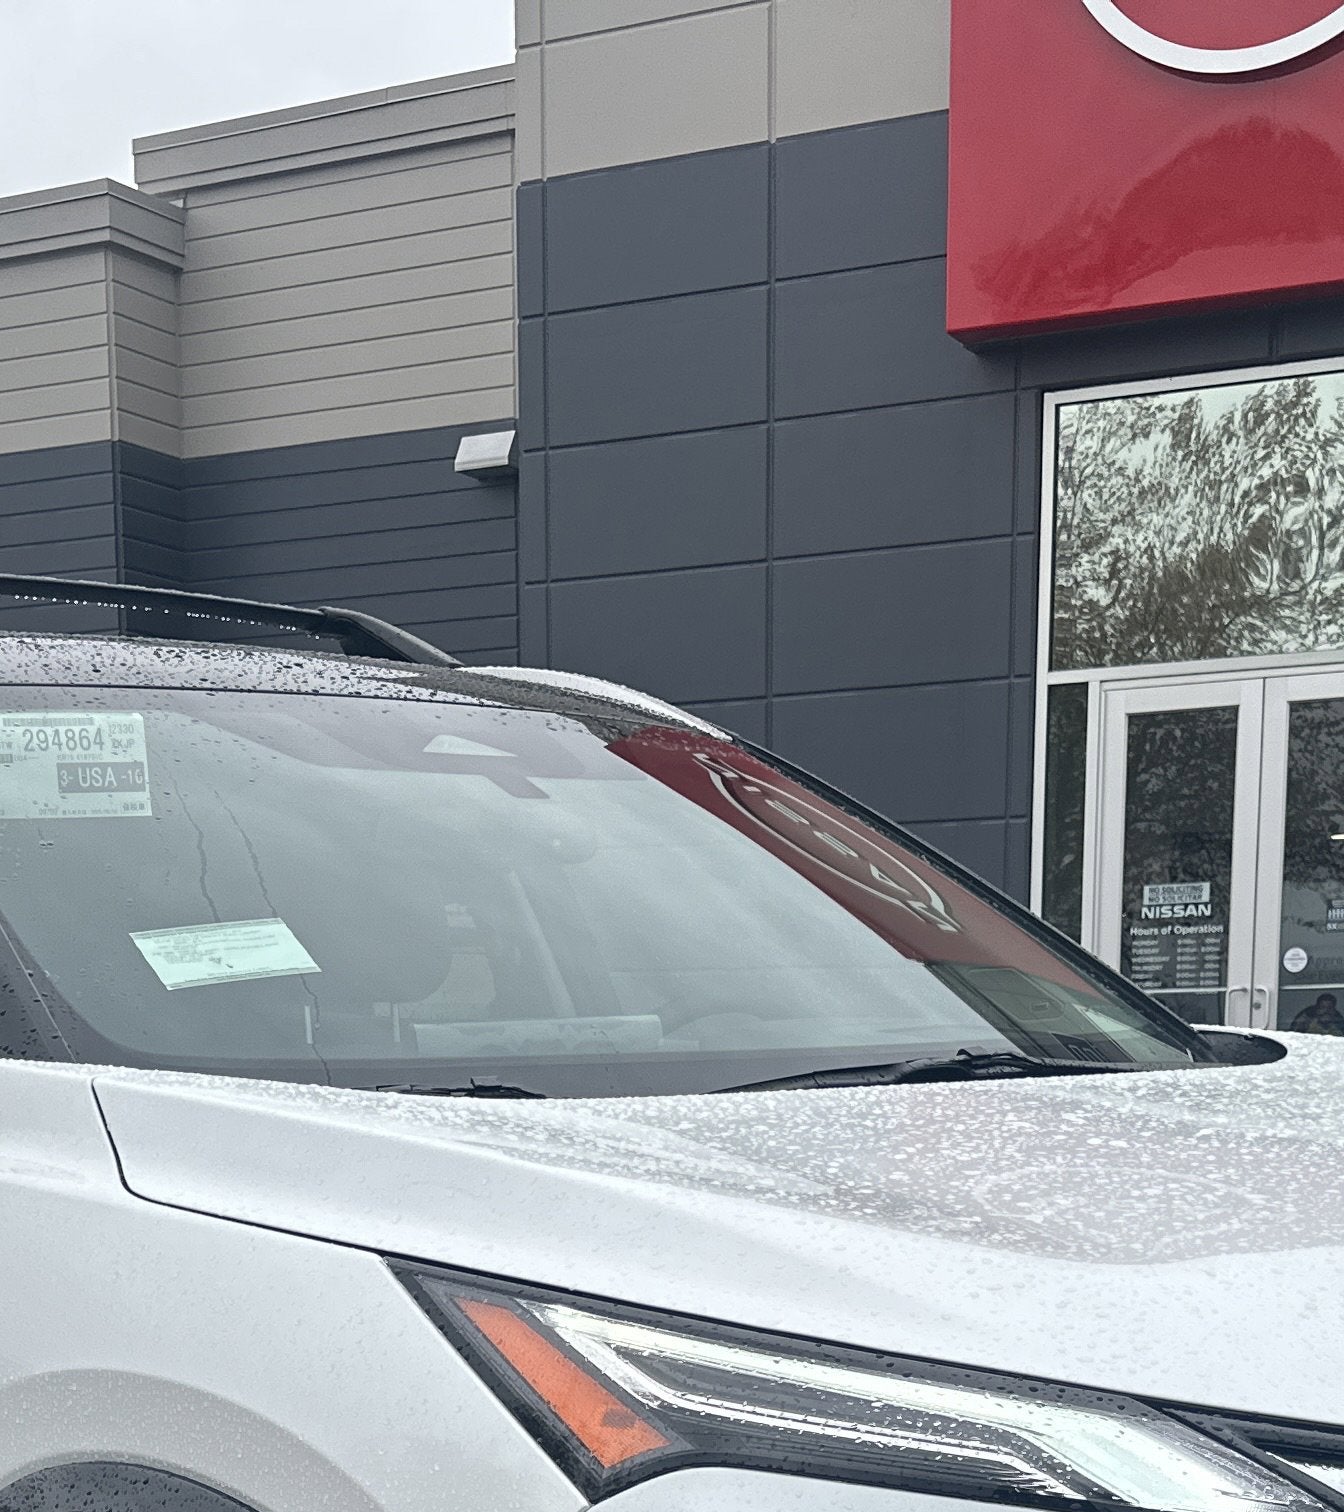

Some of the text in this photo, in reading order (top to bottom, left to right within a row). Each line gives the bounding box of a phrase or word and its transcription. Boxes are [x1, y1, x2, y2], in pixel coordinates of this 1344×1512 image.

[22, 728, 105, 752] 294864
[78, 766, 117, 788] USA
[1141, 904, 1212, 919] NISSAN
[1130, 924, 1224, 937] Hours of Operation
